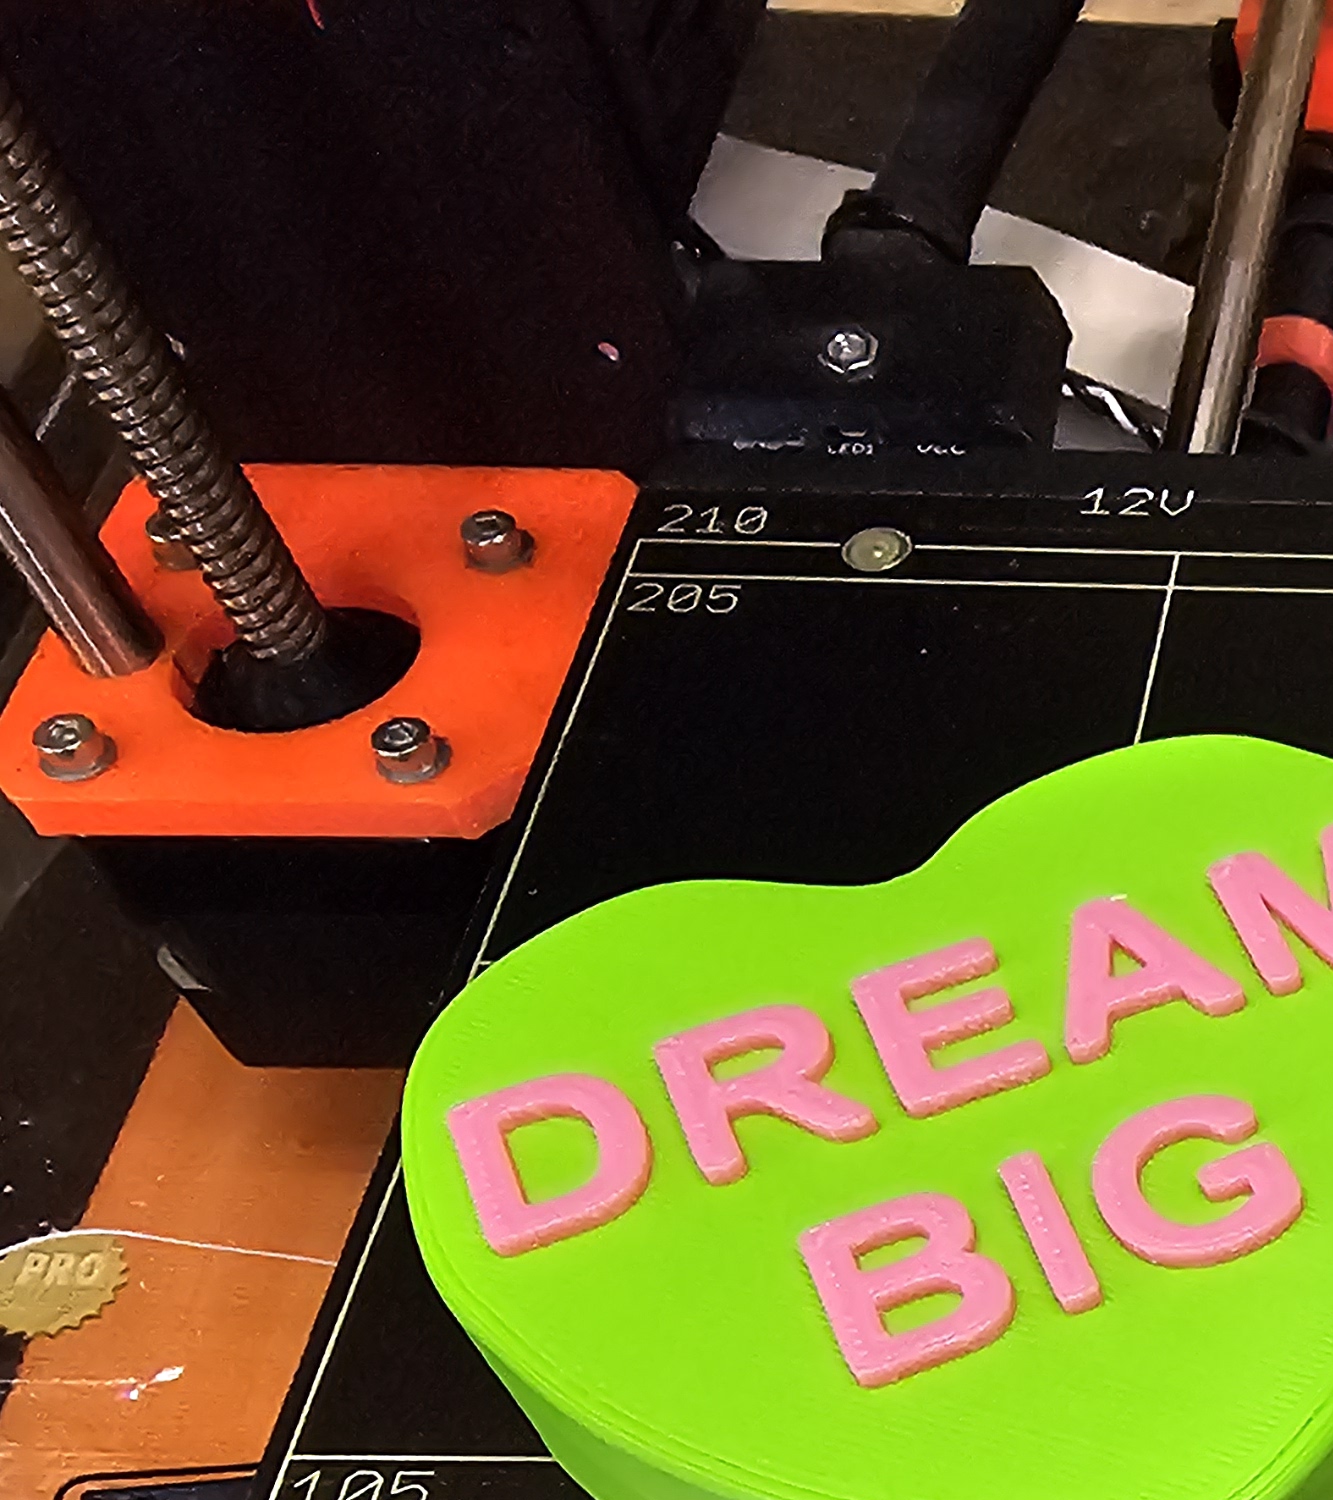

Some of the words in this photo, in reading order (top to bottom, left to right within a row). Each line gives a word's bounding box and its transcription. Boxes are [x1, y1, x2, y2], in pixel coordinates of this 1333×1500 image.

[1080, 486, 1196, 517] 12V
[656, 503, 769, 535] 210
[626, 582, 742, 614] 205
[799, 1093, 1305, 1389] BIG
[15, 1251, 104, 1286] PRO
